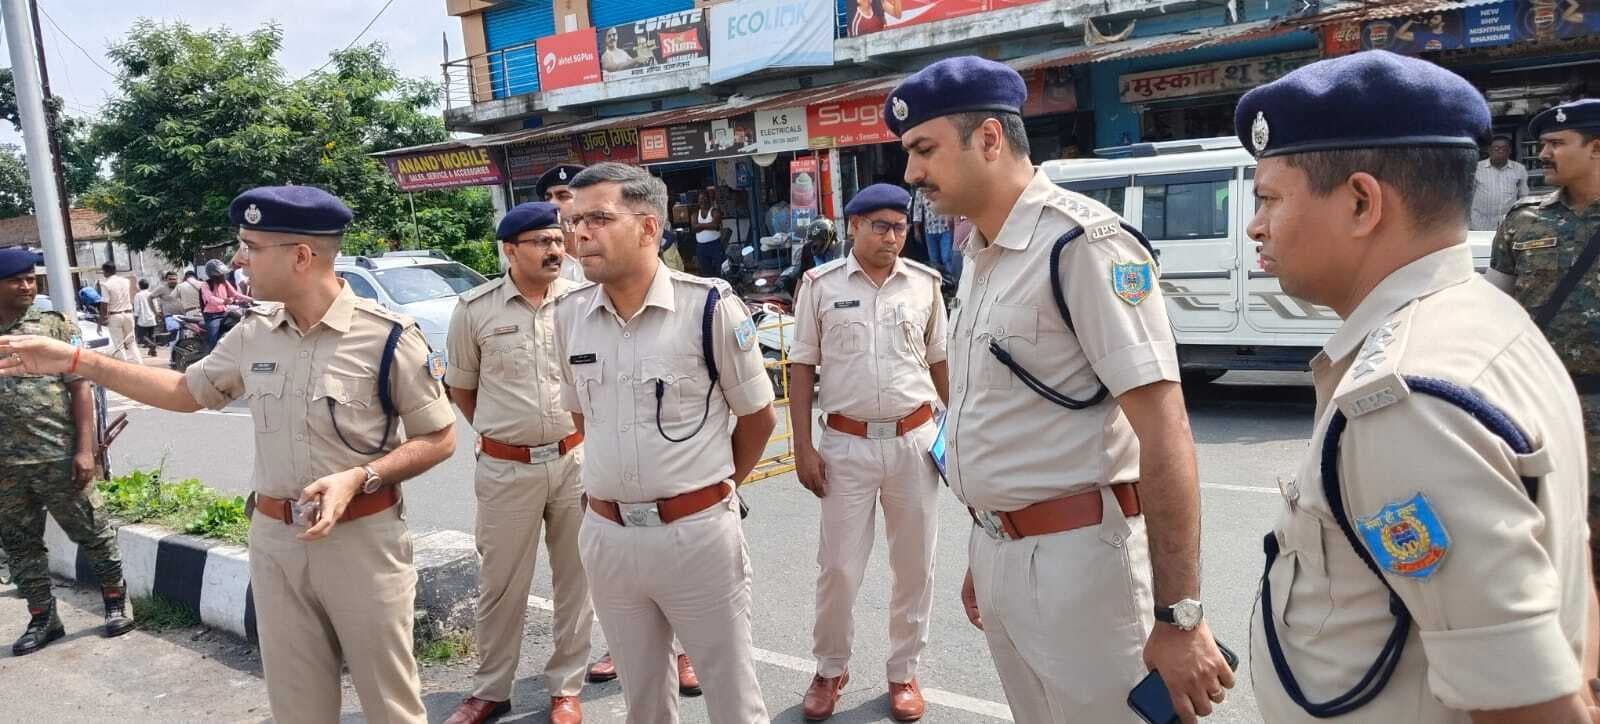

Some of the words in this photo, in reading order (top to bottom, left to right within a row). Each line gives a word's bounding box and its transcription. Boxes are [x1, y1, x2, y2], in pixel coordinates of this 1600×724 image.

[1480, 8, 1499, 17] NEW
[1470, 34, 1510, 43] BHANDAR
[760, 126, 802, 136] ELECTRICALS
[398, 155, 439, 174] ANAND
[440, 148, 491, 169] MOBILE
